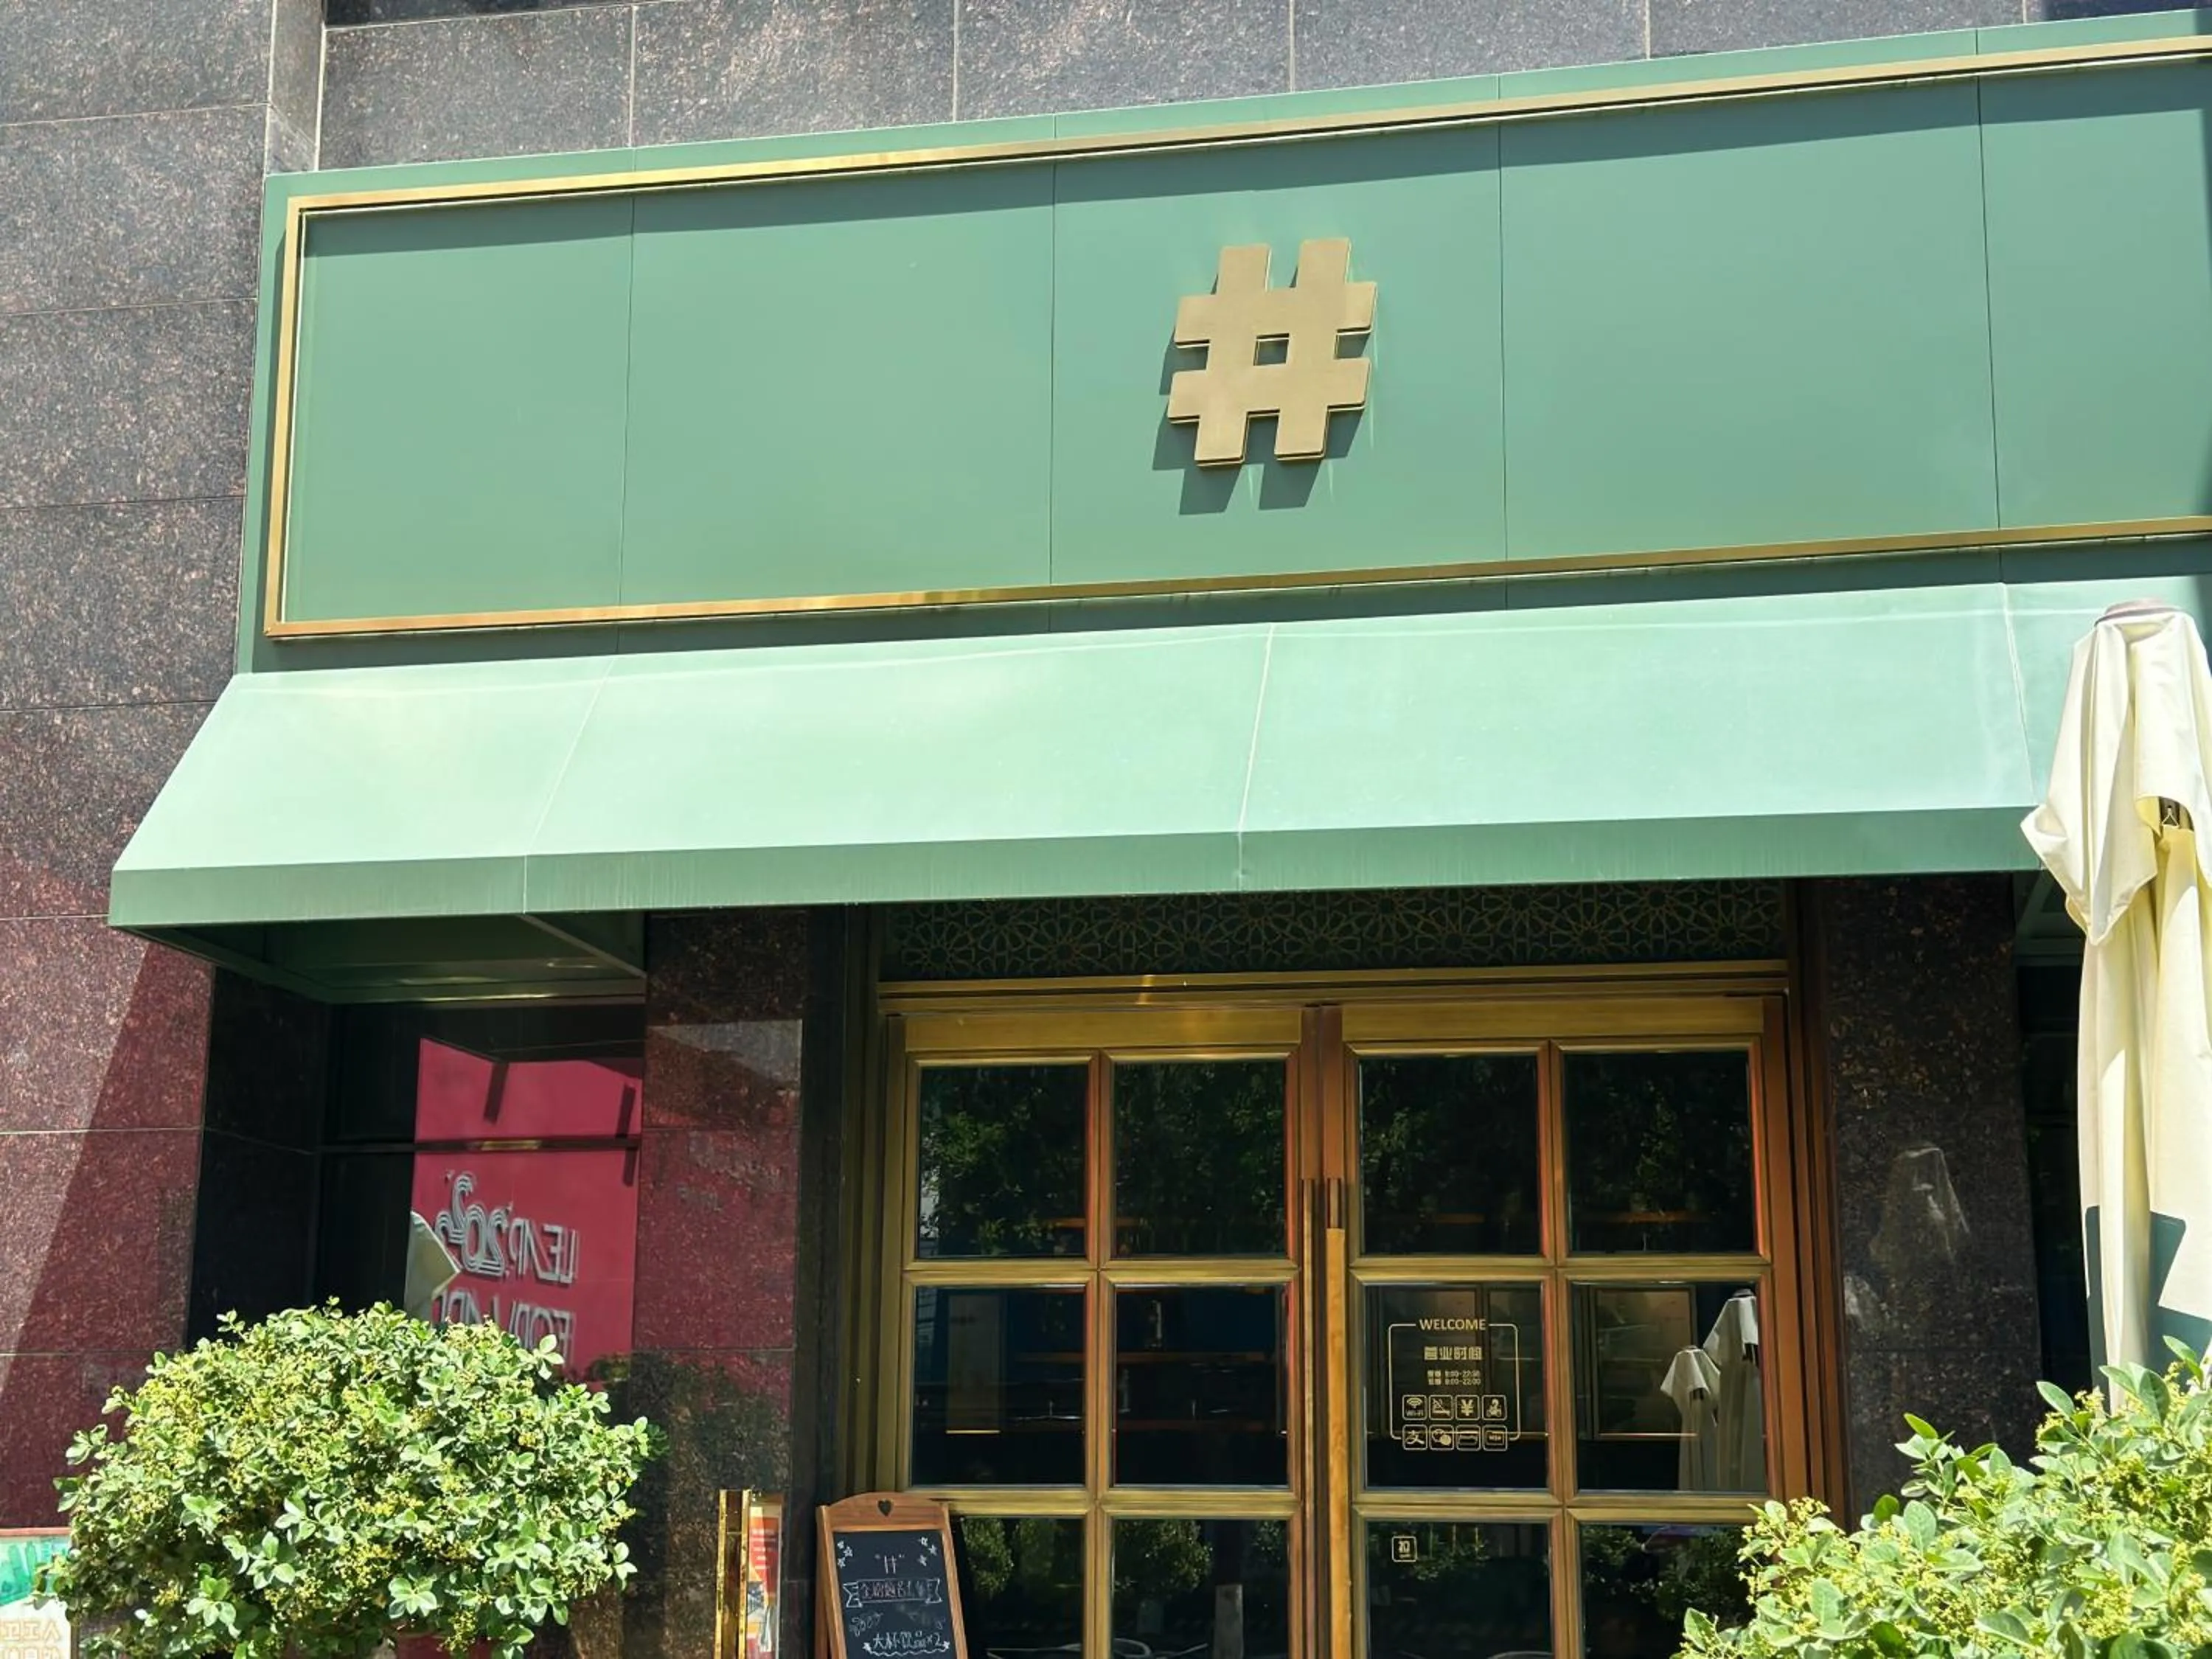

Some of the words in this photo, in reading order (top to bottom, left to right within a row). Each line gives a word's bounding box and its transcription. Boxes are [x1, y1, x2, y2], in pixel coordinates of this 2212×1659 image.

[1419, 1318, 1486, 1331] WELCOME
[1424, 1346, 1483, 1360] 营业时间
